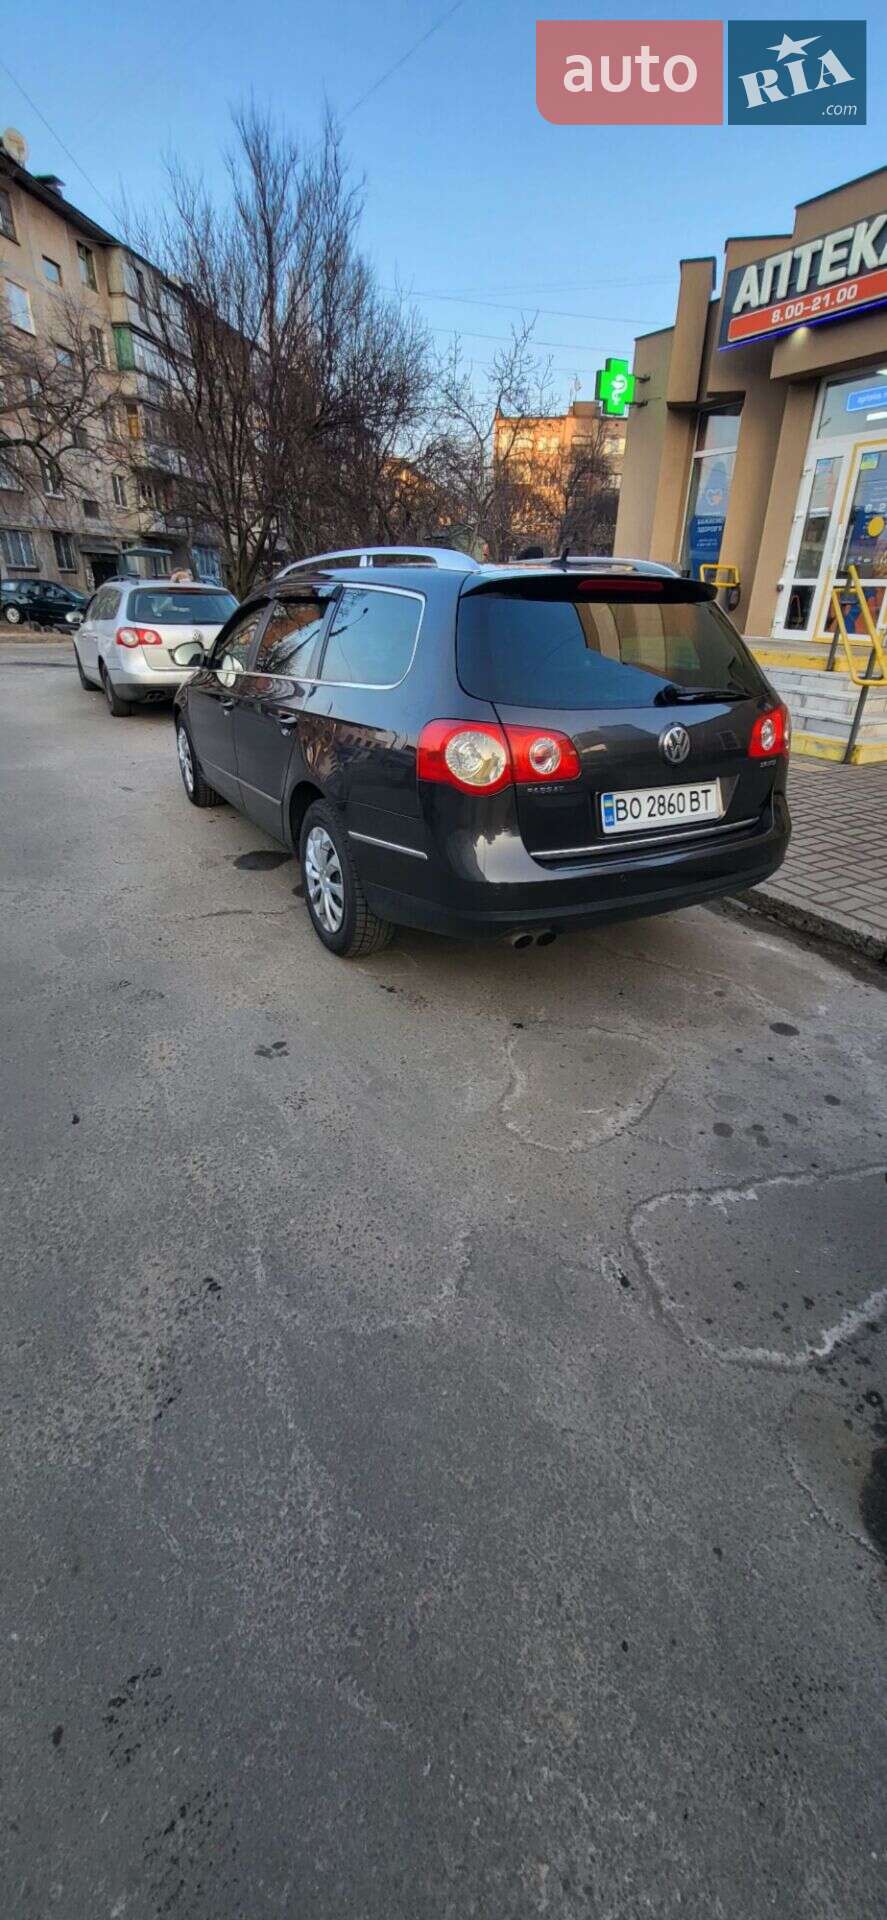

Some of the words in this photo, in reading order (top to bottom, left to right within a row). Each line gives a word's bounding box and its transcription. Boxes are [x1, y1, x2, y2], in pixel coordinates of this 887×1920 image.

[732, 214, 887, 313] АПТЕК
[771, 284, 858, 323] 8.00-21.00
[615, 797, 642, 821] BO
[647, 792, 686, 818] 2860
[689, 789, 712, 812] BT
